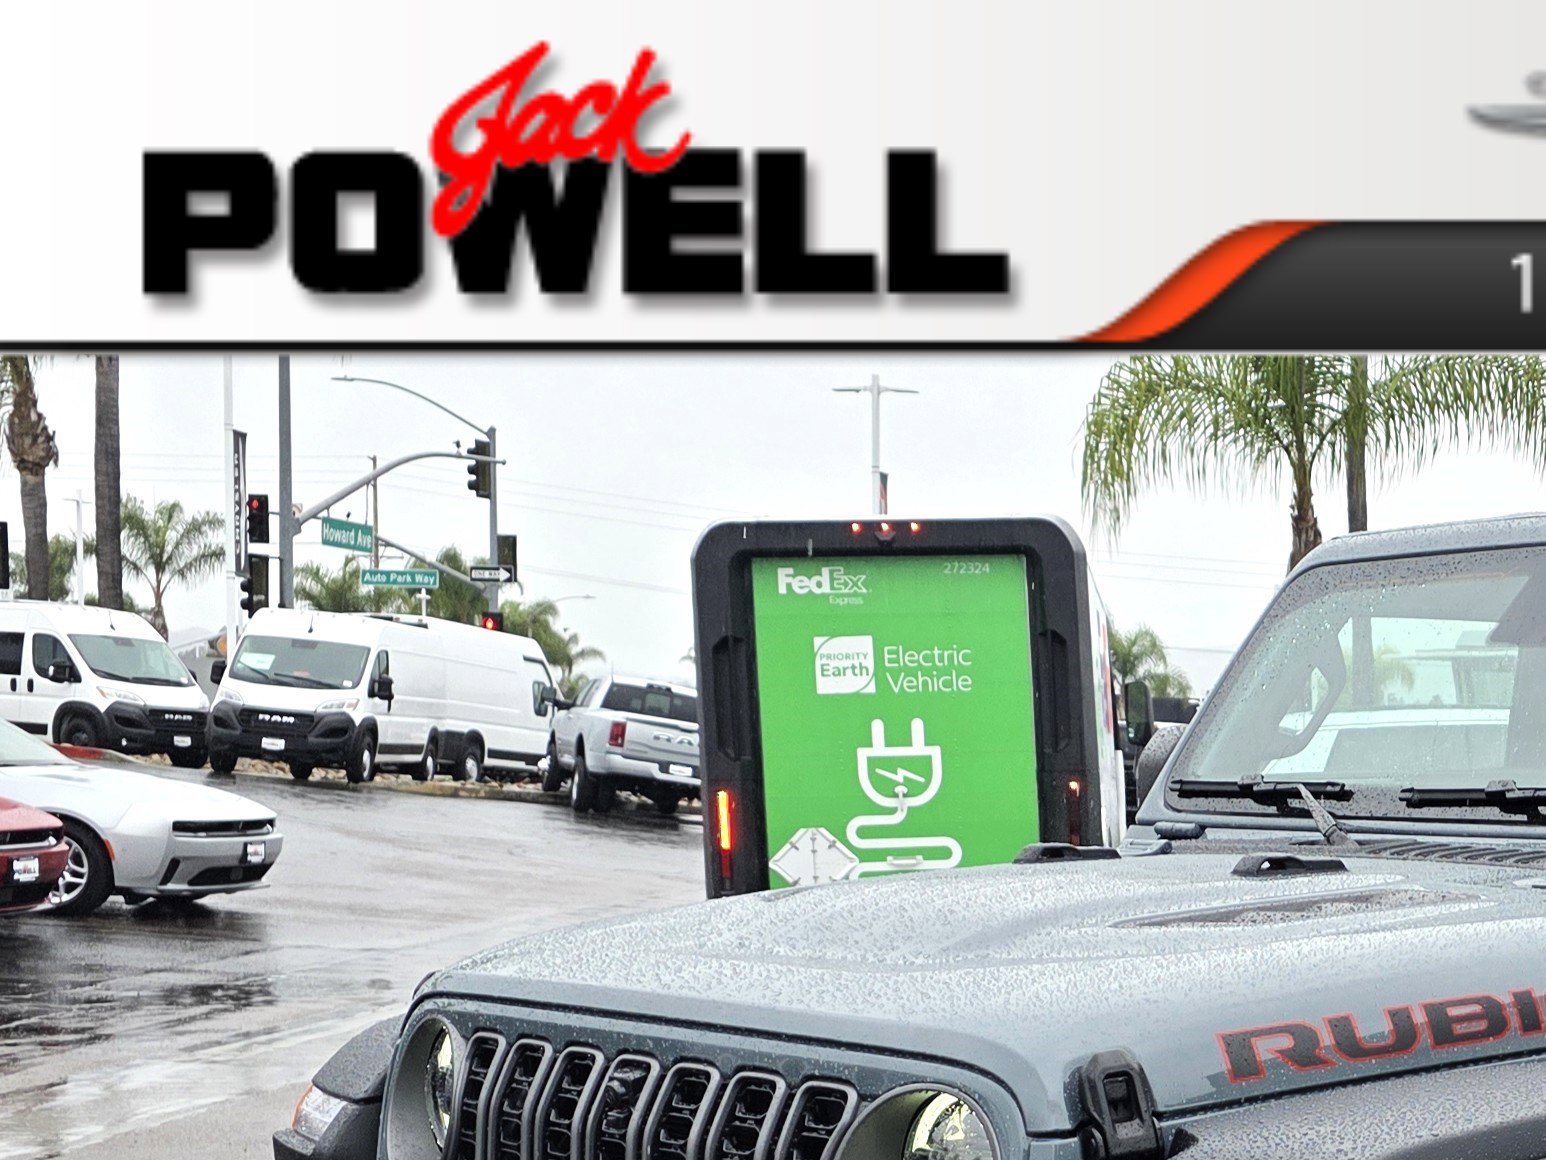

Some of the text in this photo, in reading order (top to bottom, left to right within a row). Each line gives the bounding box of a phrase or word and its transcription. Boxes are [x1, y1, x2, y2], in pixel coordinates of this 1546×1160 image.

[323, 522, 372, 549] Howard Ave
[943, 560, 990, 575] 272324
[363, 572, 435, 586] Auto Park Way
[777, 566, 868, 595] FedEx
[829, 595, 864, 606] Express
[819, 652, 869, 662] PRIORITY
[883, 644, 973, 667] Electric
[820, 663, 870, 678] Earth
[886, 670, 973, 694] Vehicle
